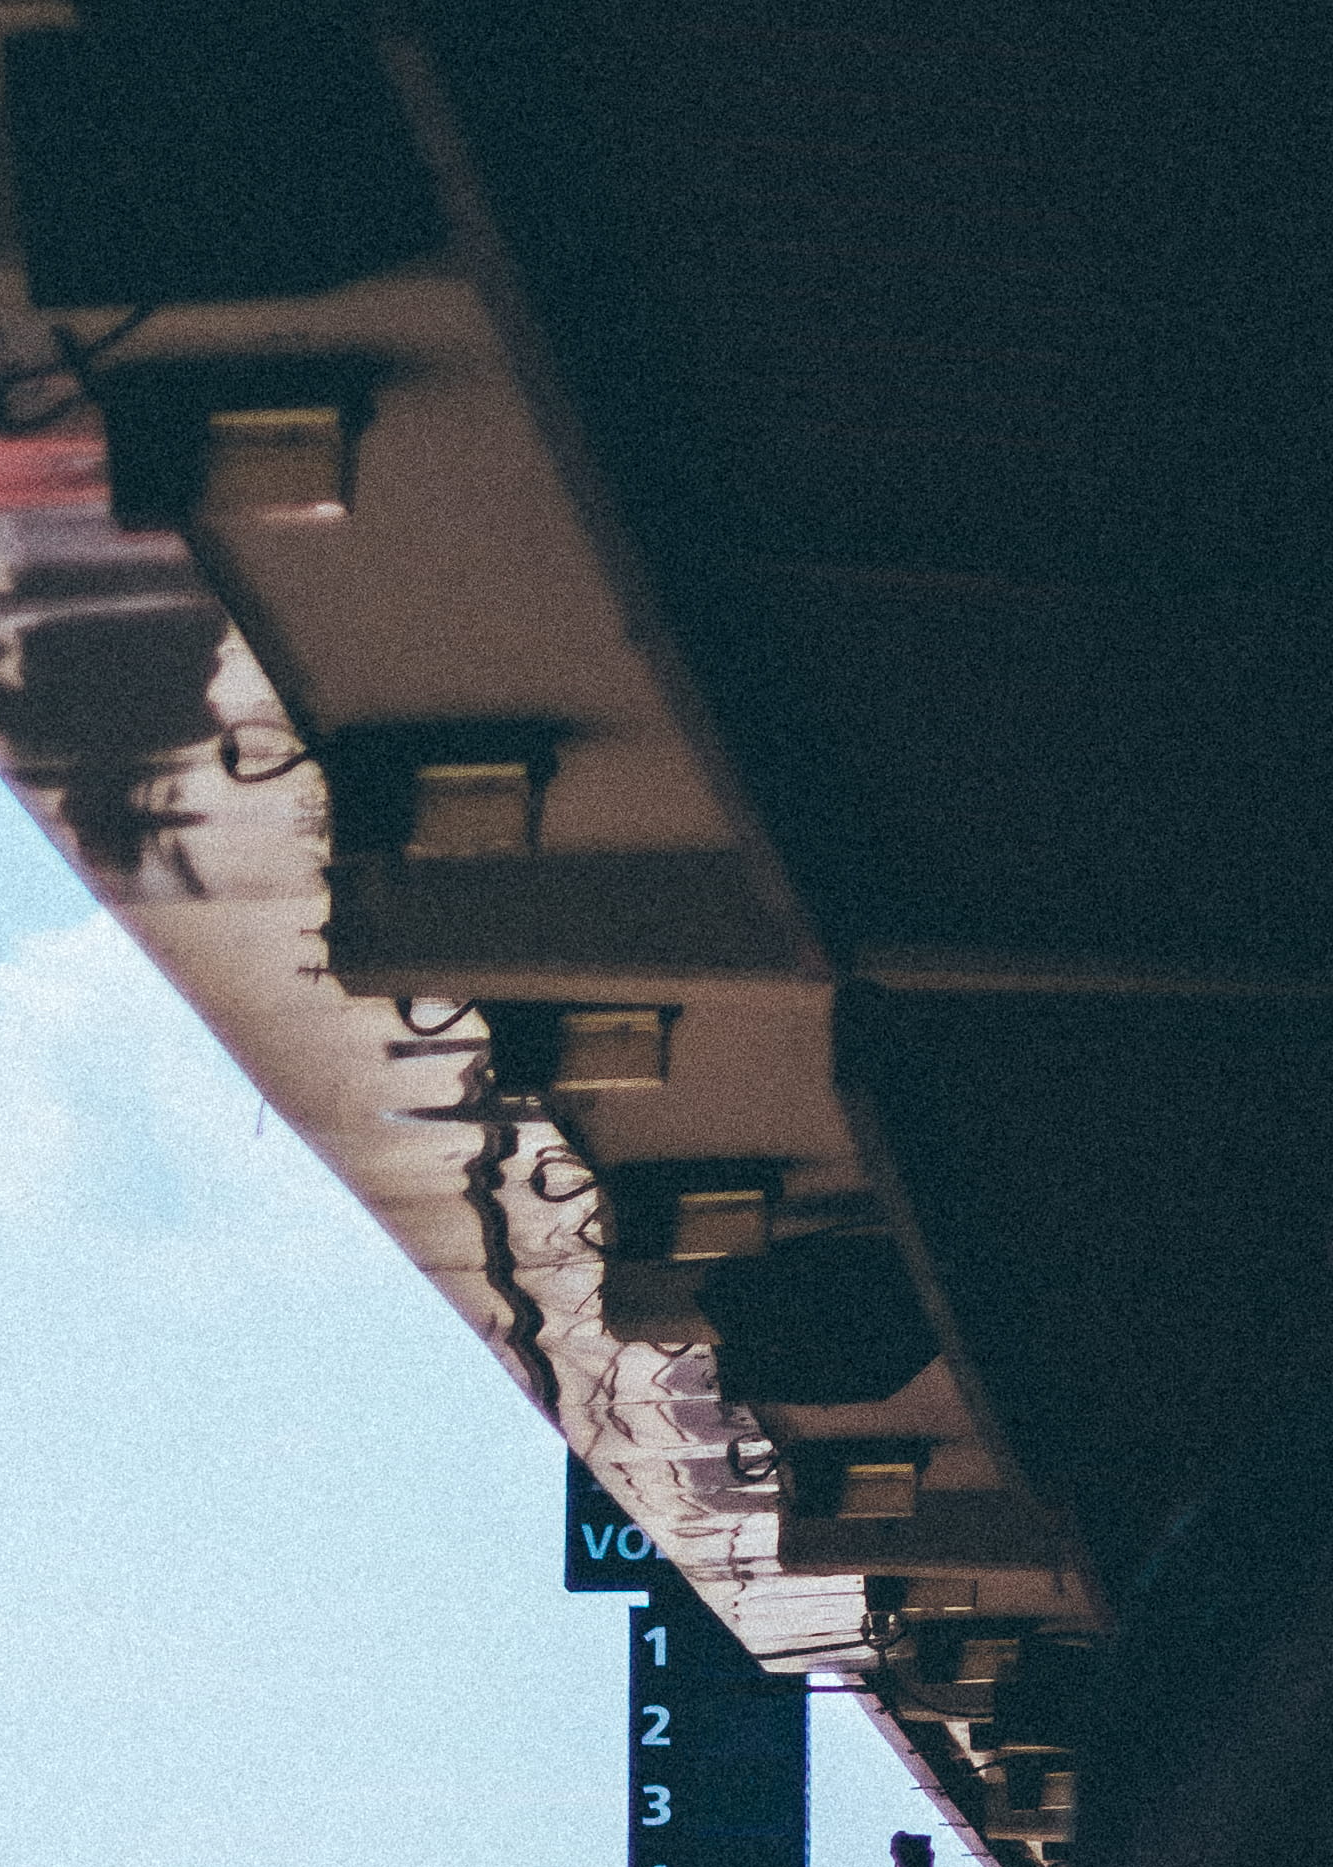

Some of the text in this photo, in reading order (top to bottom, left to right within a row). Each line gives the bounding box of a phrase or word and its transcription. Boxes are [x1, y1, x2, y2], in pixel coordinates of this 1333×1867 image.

[582, 1523, 669, 1560] VO
[643, 1626, 667, 1666] 1
[641, 1705, 671, 1746] 2
[642, 1785, 672, 1826] 3
